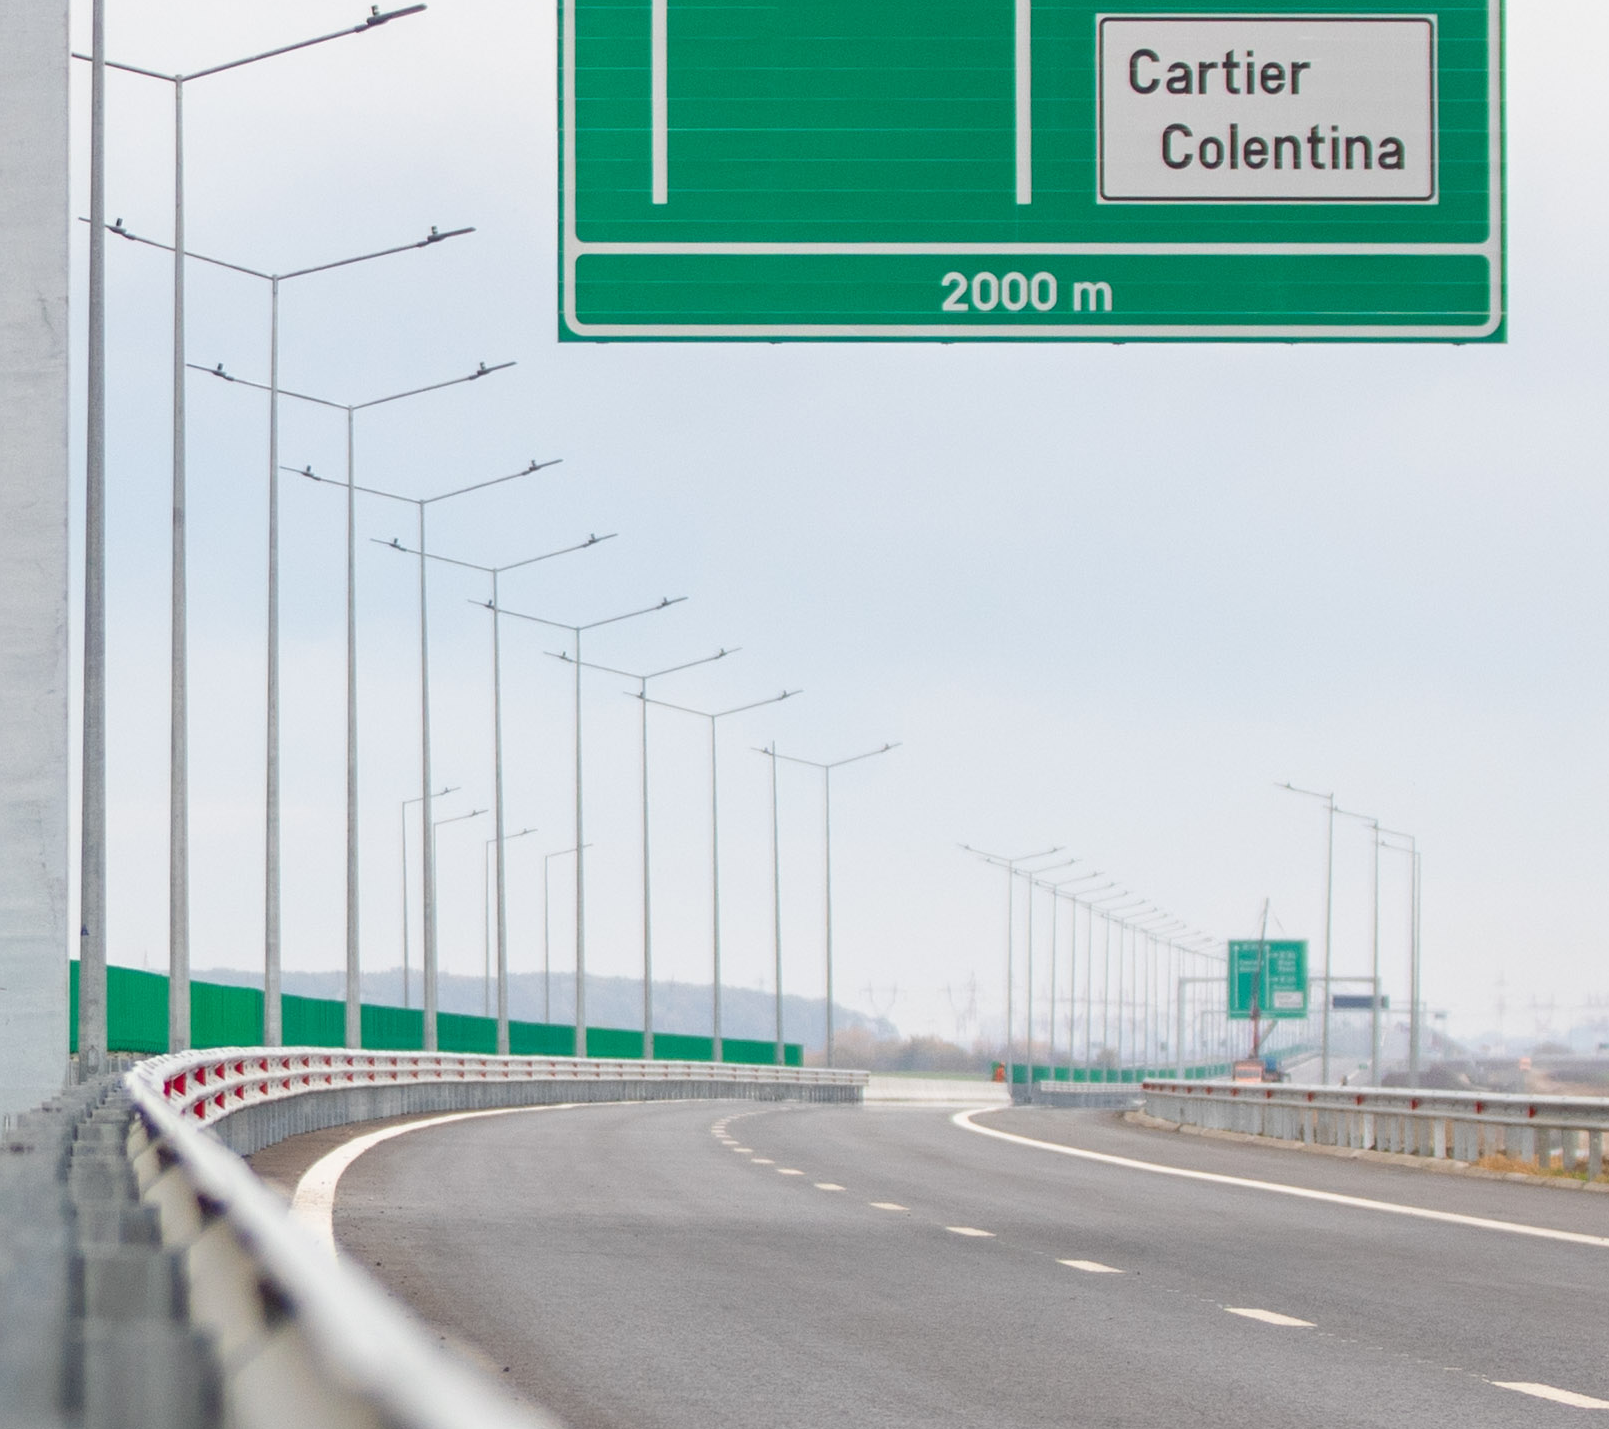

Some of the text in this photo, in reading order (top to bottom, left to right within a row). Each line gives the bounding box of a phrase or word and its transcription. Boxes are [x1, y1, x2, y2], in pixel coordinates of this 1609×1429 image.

[1129, 49, 1311, 95] Cartier
[1162, 124, 1405, 170] Colentina
[942, 272, 1113, 312] 2000 m
